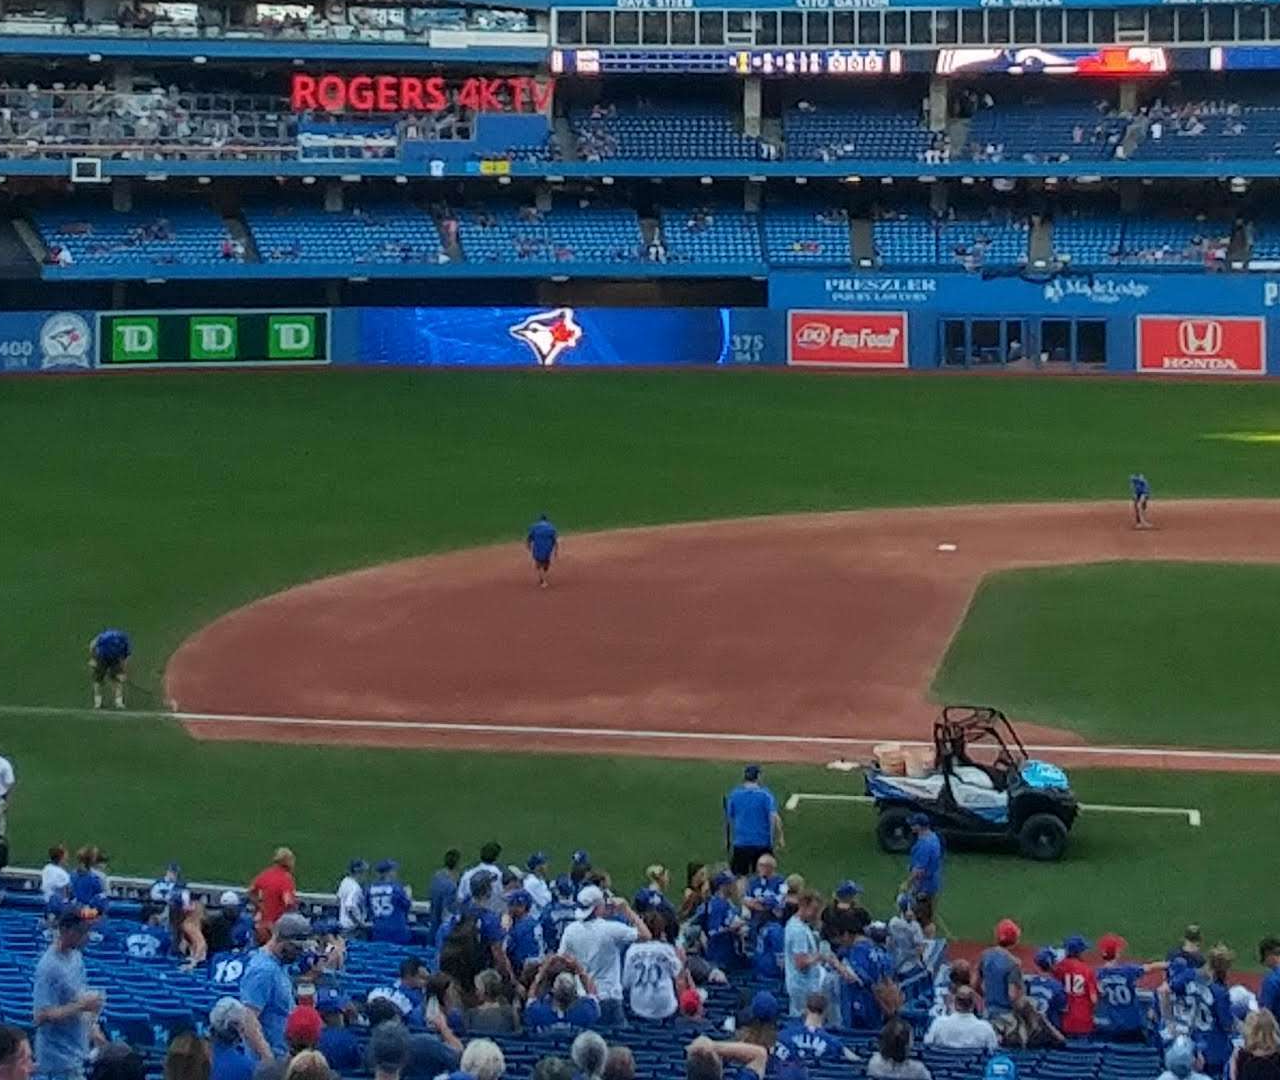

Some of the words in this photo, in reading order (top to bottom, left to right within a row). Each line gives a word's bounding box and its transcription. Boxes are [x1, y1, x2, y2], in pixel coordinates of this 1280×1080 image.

[291, 72, 446, 112] ROGERS
[458, 77, 507, 112] 4K
[510, 78, 556, 114] TV
[825, 279, 937, 291] PRESZLER
[116, 324, 154, 352] TD
[194, 324, 232, 351] TD
[273, 323, 311, 350] TD
[732, 334, 764, 350] 375
[800, 328, 825, 342] DQ
[1162, 357, 1237, 369] HONDA
